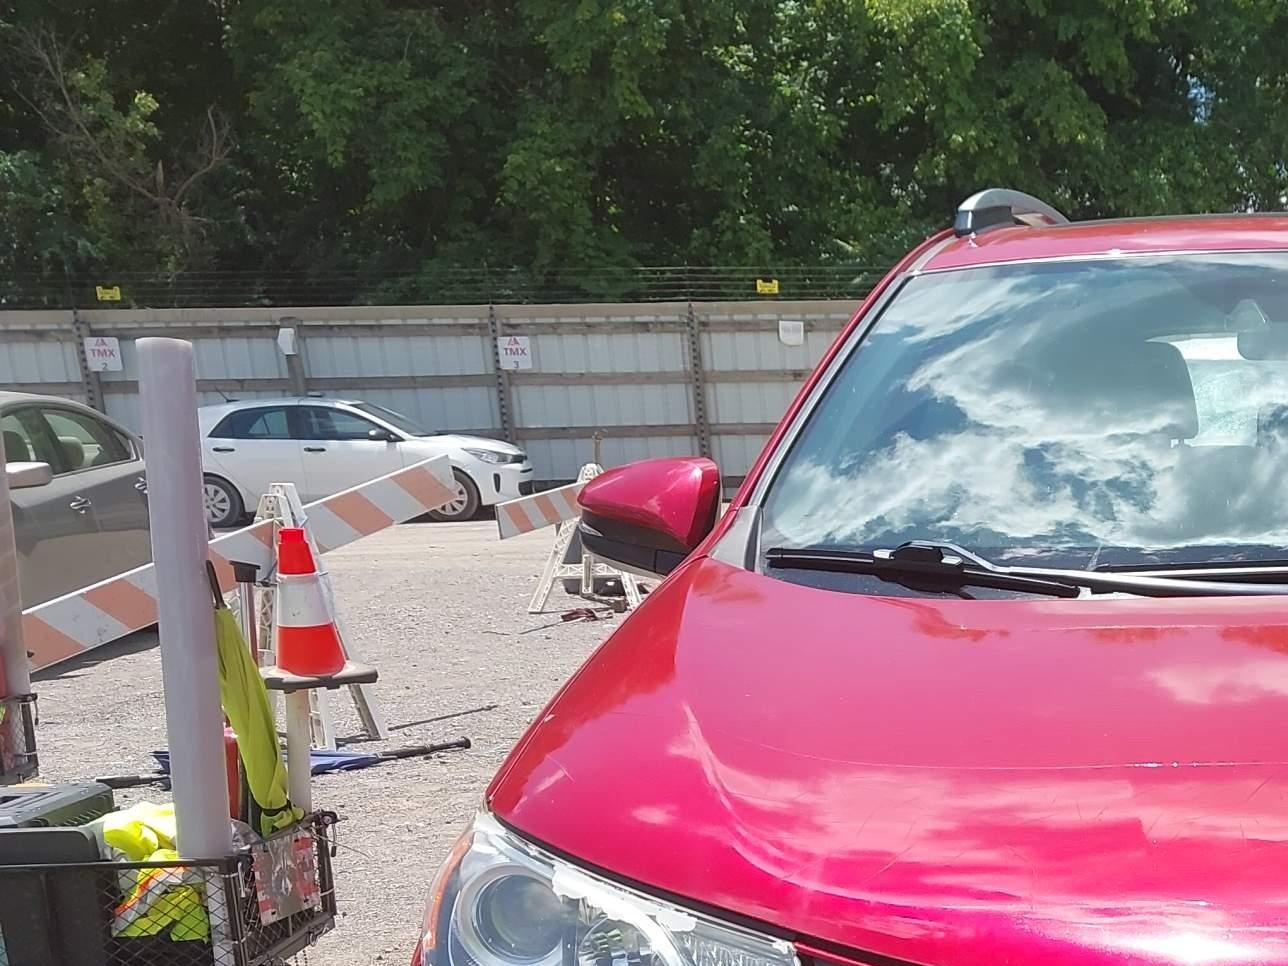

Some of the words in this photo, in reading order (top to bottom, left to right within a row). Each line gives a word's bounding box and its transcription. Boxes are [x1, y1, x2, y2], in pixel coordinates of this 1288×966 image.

[90, 348, 116, 358] TMX
[503, 347, 527, 356] TMX
[101, 362, 108, 371] 2
[513, 360, 520, 369] 3
